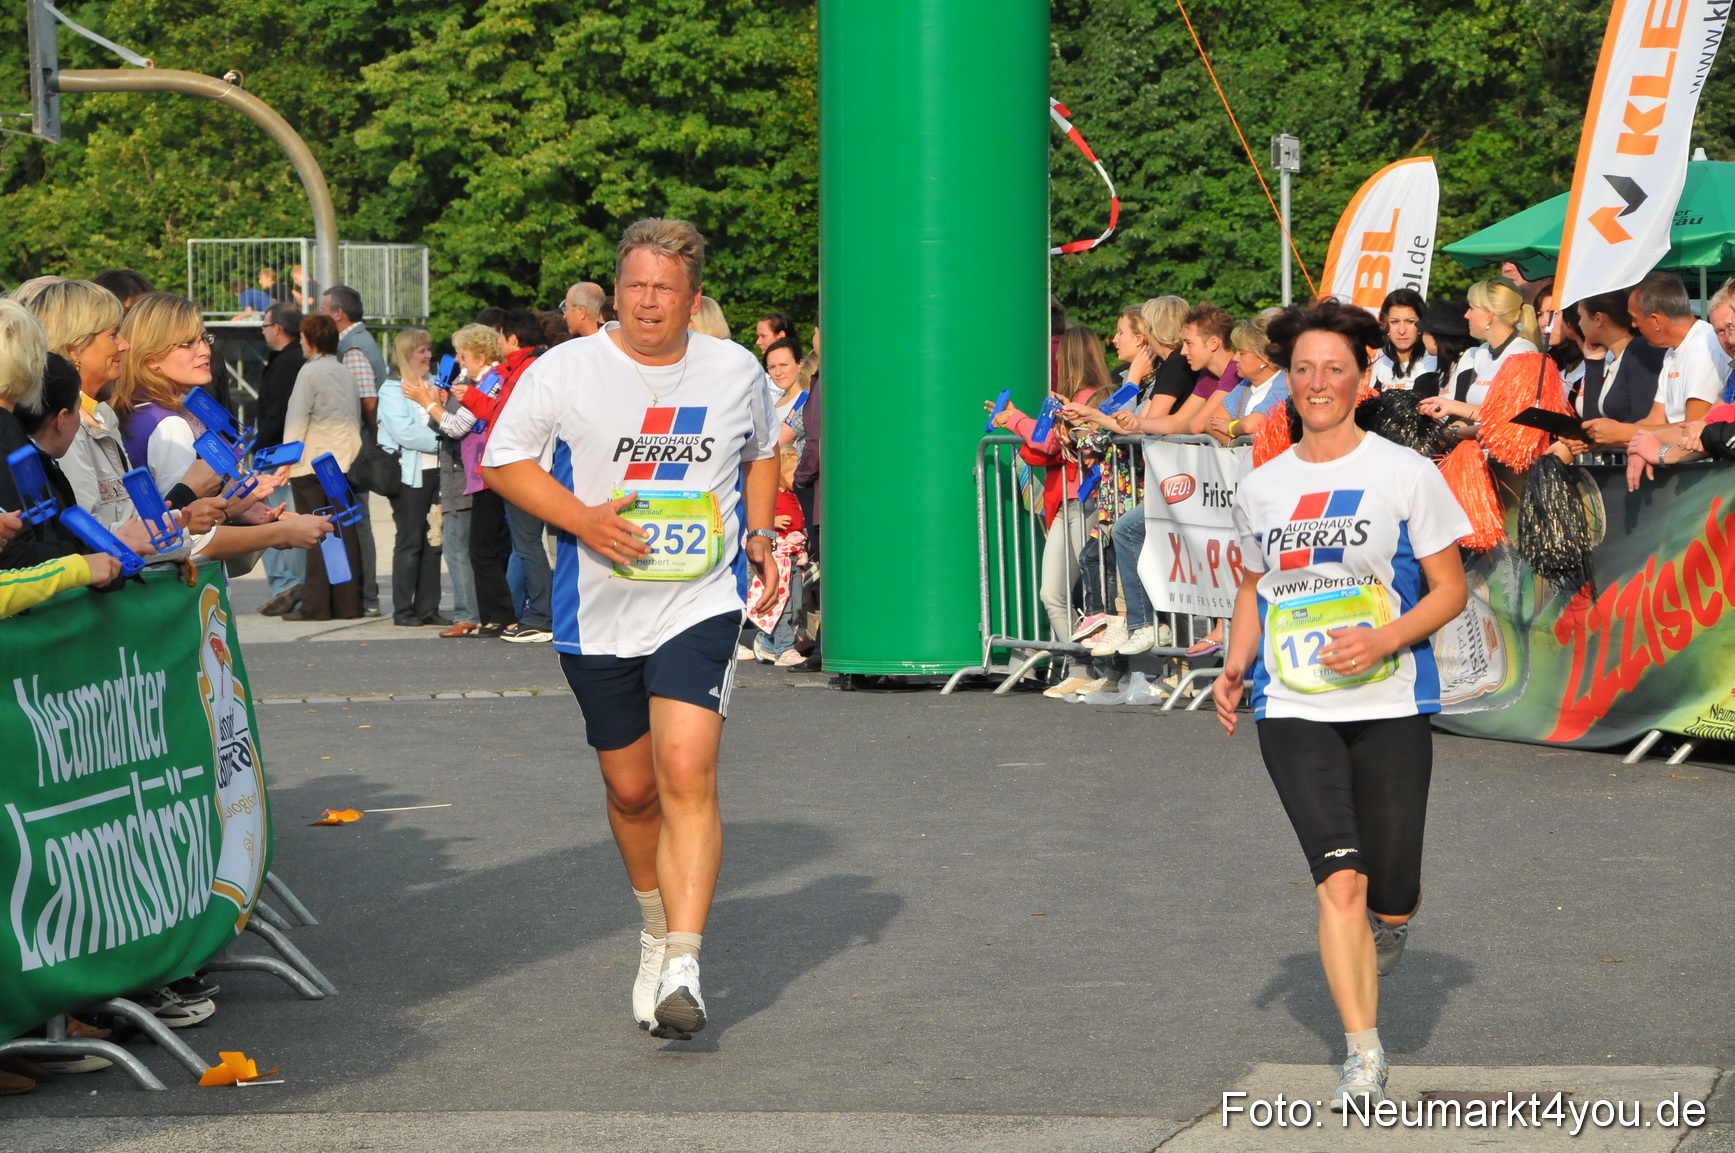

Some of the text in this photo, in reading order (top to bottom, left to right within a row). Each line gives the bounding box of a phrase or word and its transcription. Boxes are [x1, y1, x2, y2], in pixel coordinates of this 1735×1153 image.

[612, 437, 716, 463] PERRAS
[636, 436, 700, 446] AUTOHAUS
[1163, 480, 1192, 499] NEU!
[1202, 482, 1238, 509] Frisc
[625, 523, 706, 555] 252
[1267, 519, 1371, 556] PERRAS
[1284, 518, 1353, 533] AUTOHAUS
[13, 646, 167, 788] Neumarkter
[5, 766, 212, 972] Lammsbräu
